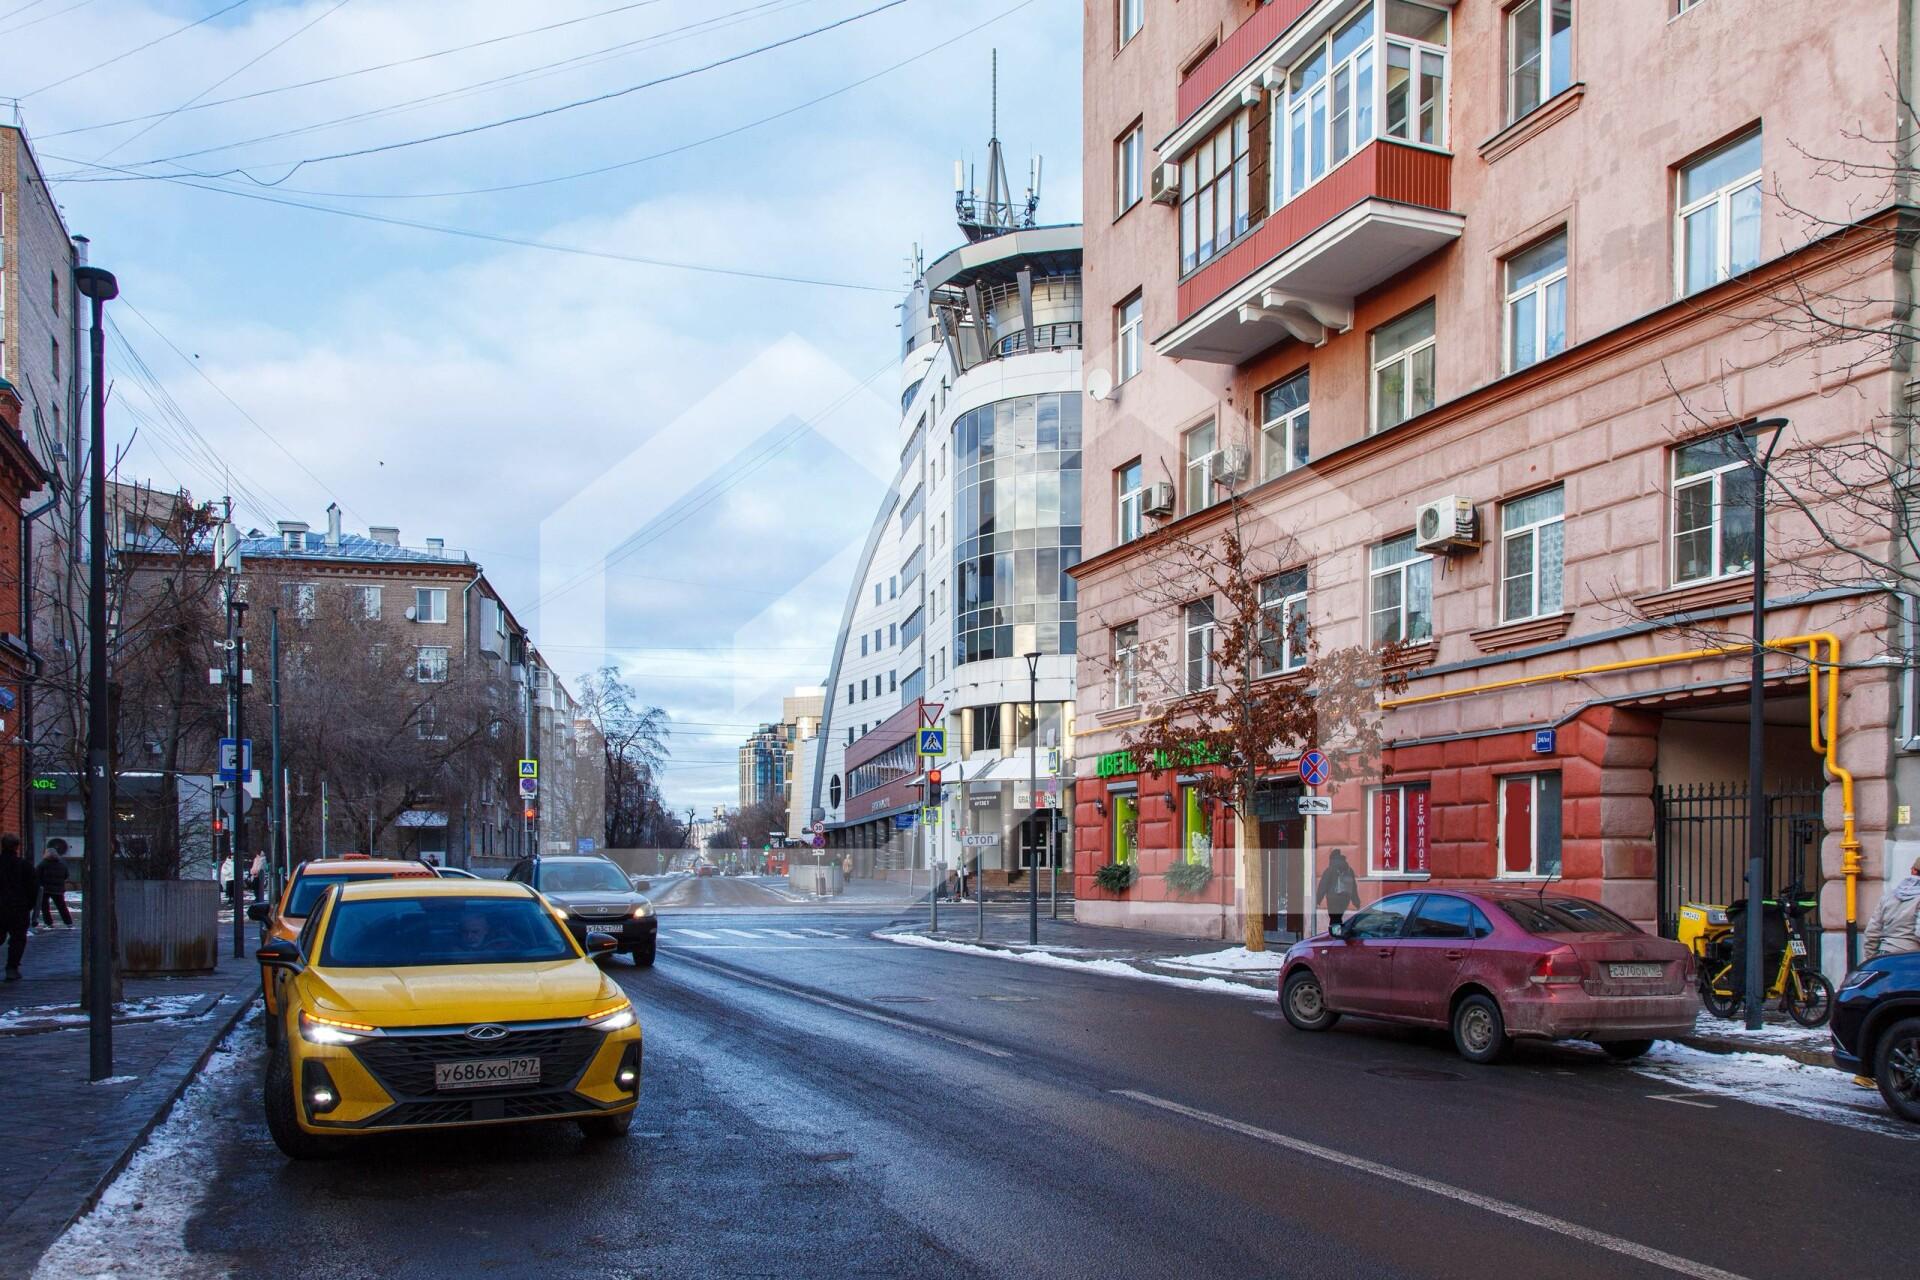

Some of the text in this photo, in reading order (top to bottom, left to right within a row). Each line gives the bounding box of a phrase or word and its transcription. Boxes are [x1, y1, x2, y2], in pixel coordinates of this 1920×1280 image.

[967, 835, 994, 845] СТОП
[1417, 793, 1425, 870] НЕЖИЛОЕ
[441, 1064, 509, 1082] У686ХО
[511, 1059, 537, 1073] 797
